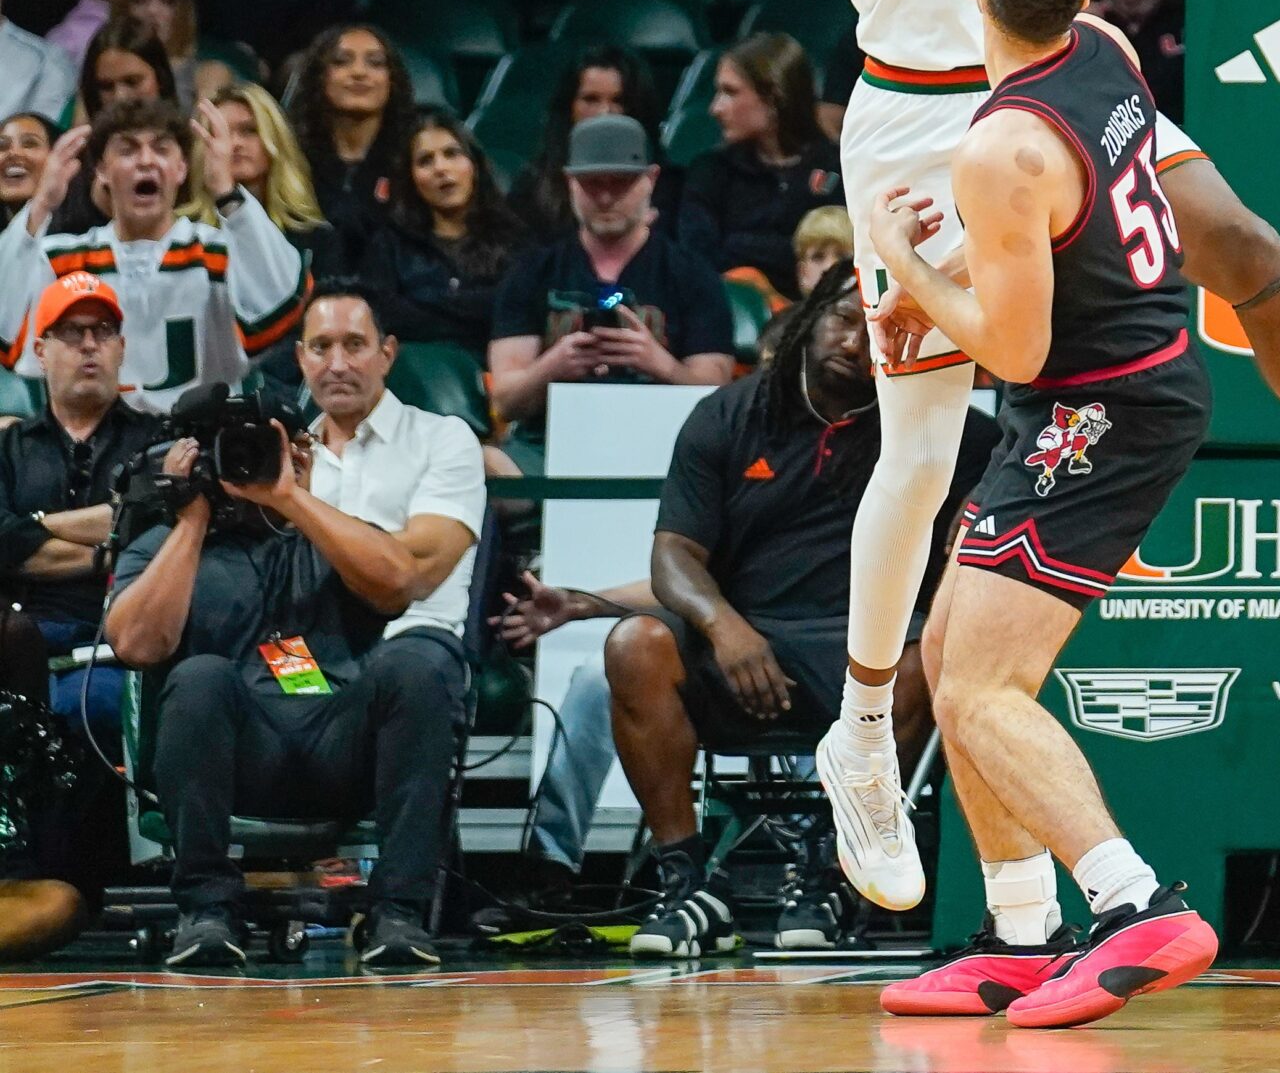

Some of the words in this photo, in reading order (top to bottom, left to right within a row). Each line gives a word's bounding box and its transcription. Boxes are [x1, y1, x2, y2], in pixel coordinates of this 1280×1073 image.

[1101, 94, 1146, 167] ZOUGRIS
[1100, 598, 1215, 620] UNIVERSITY
[1217, 598, 1245, 619] OF
